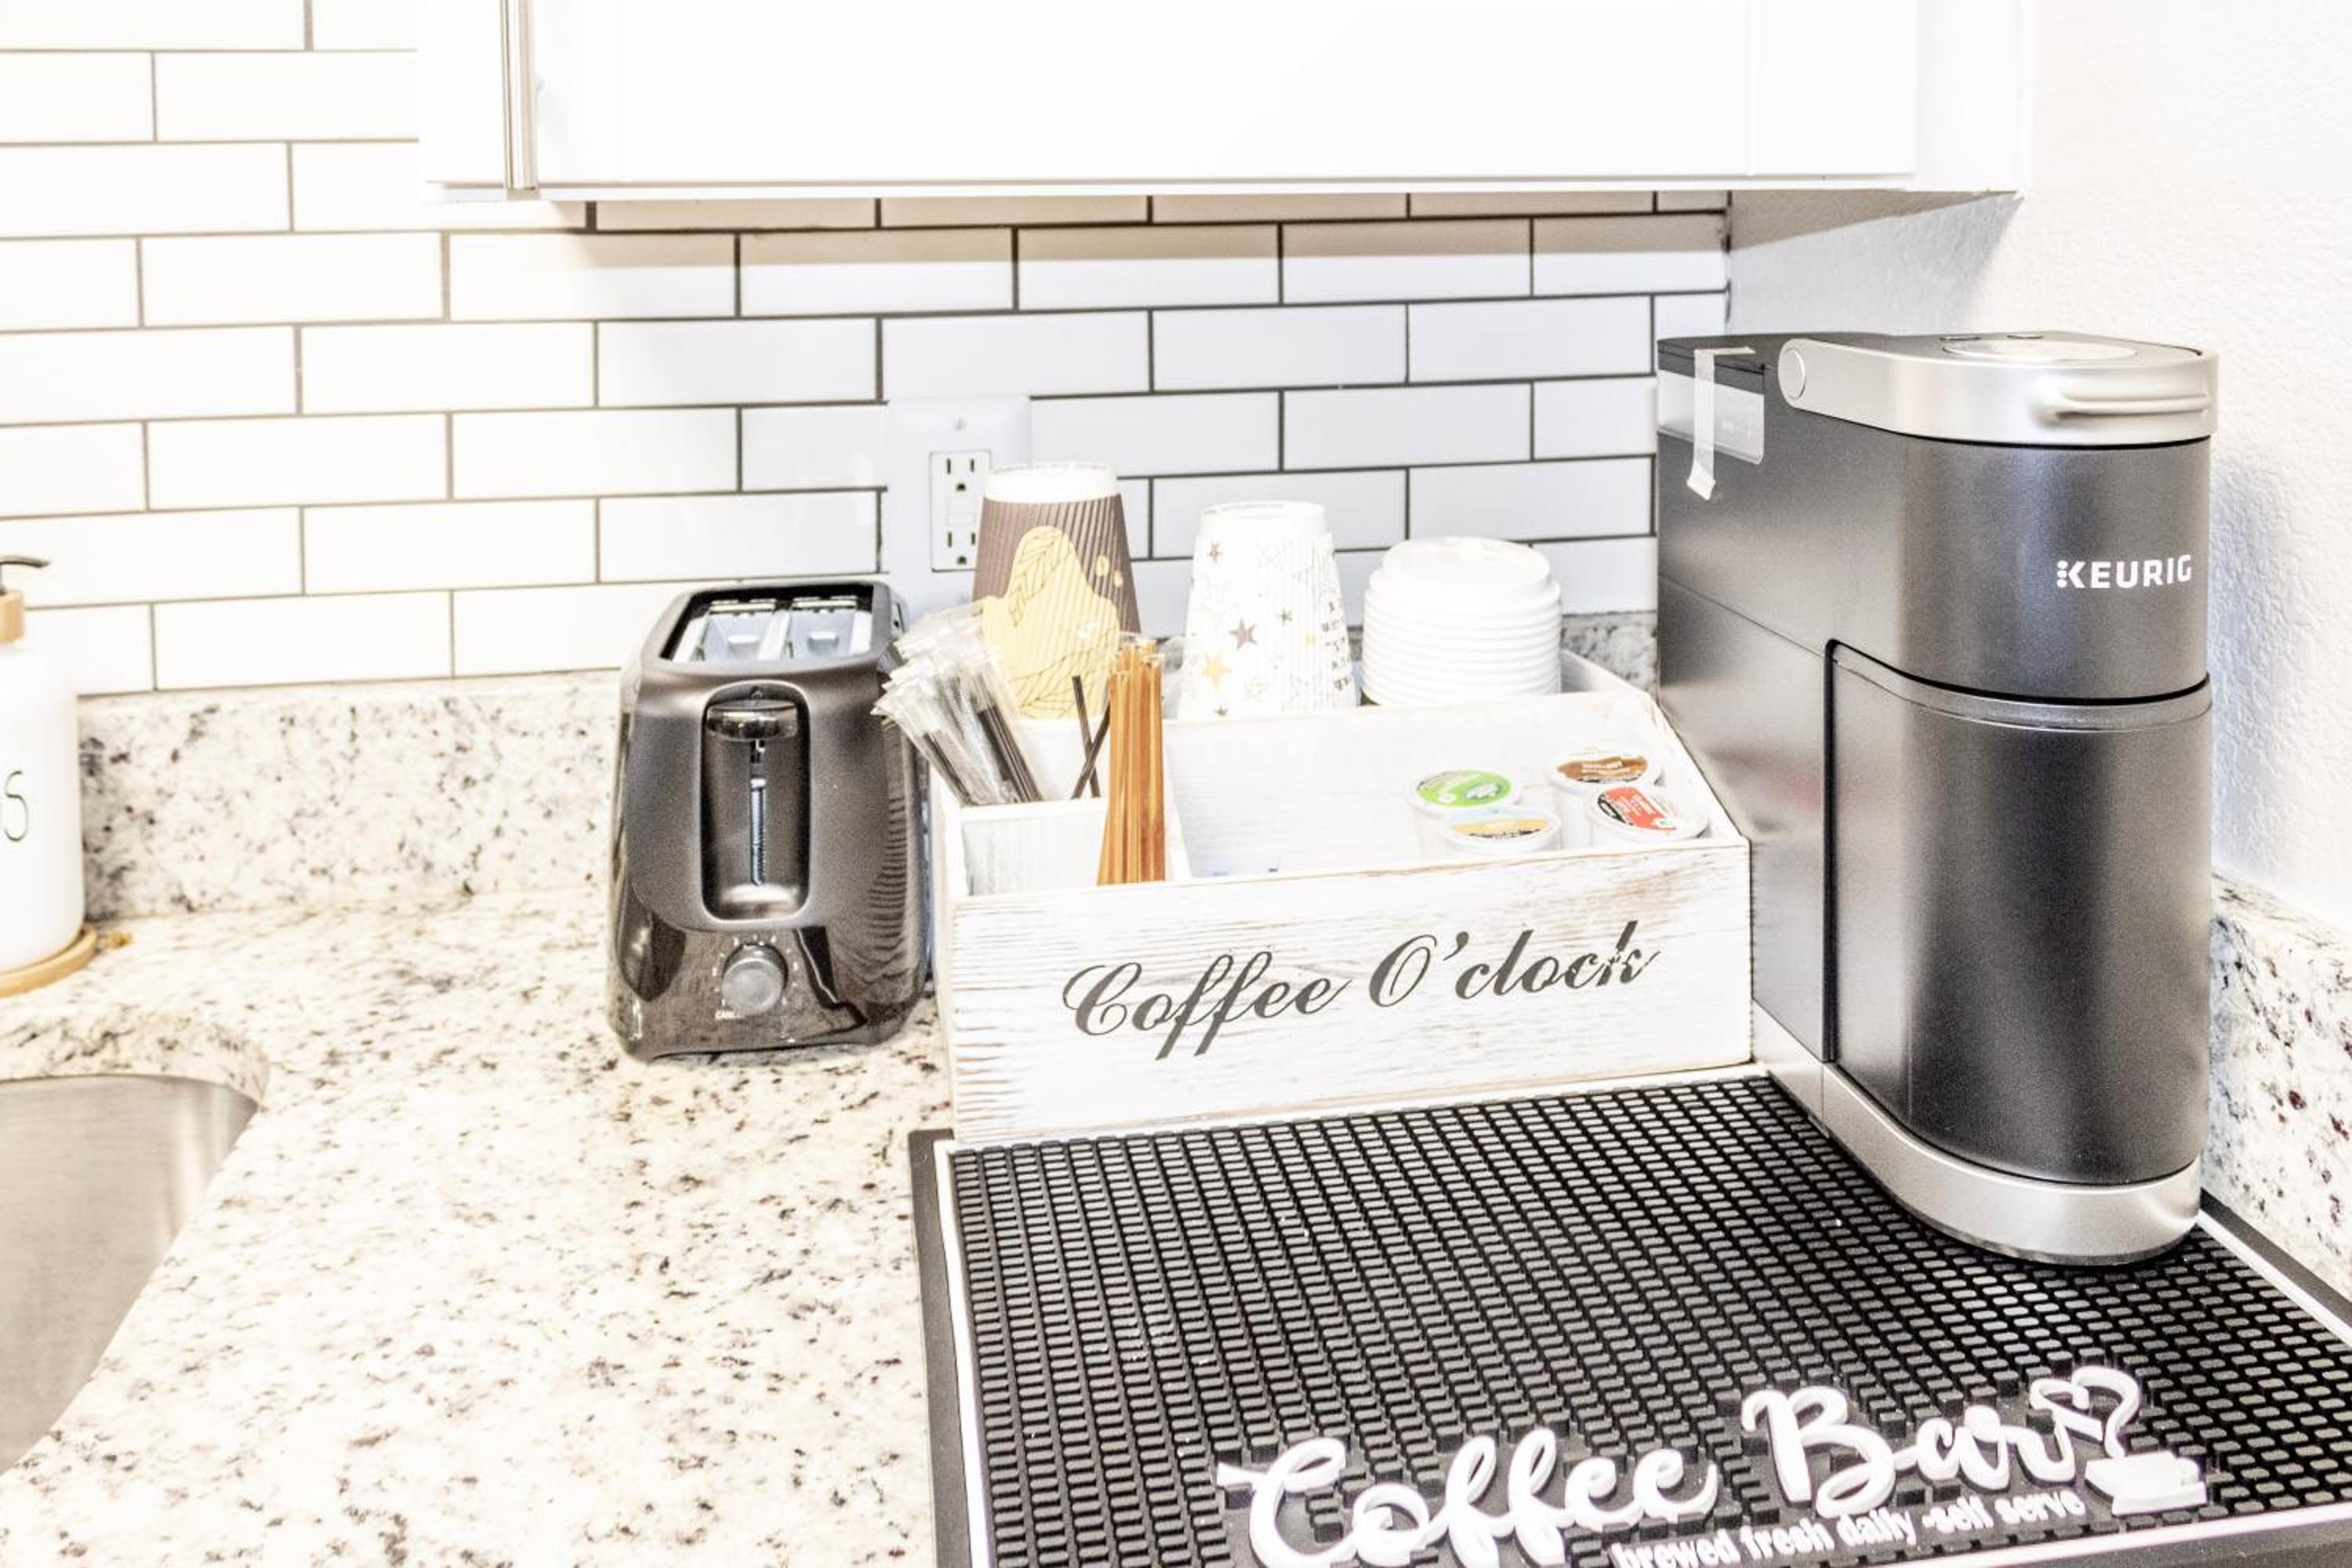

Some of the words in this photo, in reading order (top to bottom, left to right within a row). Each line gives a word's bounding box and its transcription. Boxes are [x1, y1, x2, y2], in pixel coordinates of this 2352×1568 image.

[2056, 554, 2192, 589] KEURIG
[1062, 950, 1350, 1060] Coffee
[1367, 920, 1659, 1007] O'clock
[1216, 1428, 1718, 1568] Coffee
[1741, 1385, 2076, 1517] Bar
[1611, 1528, 1741, 1568] brewed
[1740, 1518, 1835, 1559] fresh
[1837, 1506, 1917, 1546] daily
[1994, 1489, 2086, 1524] serve
